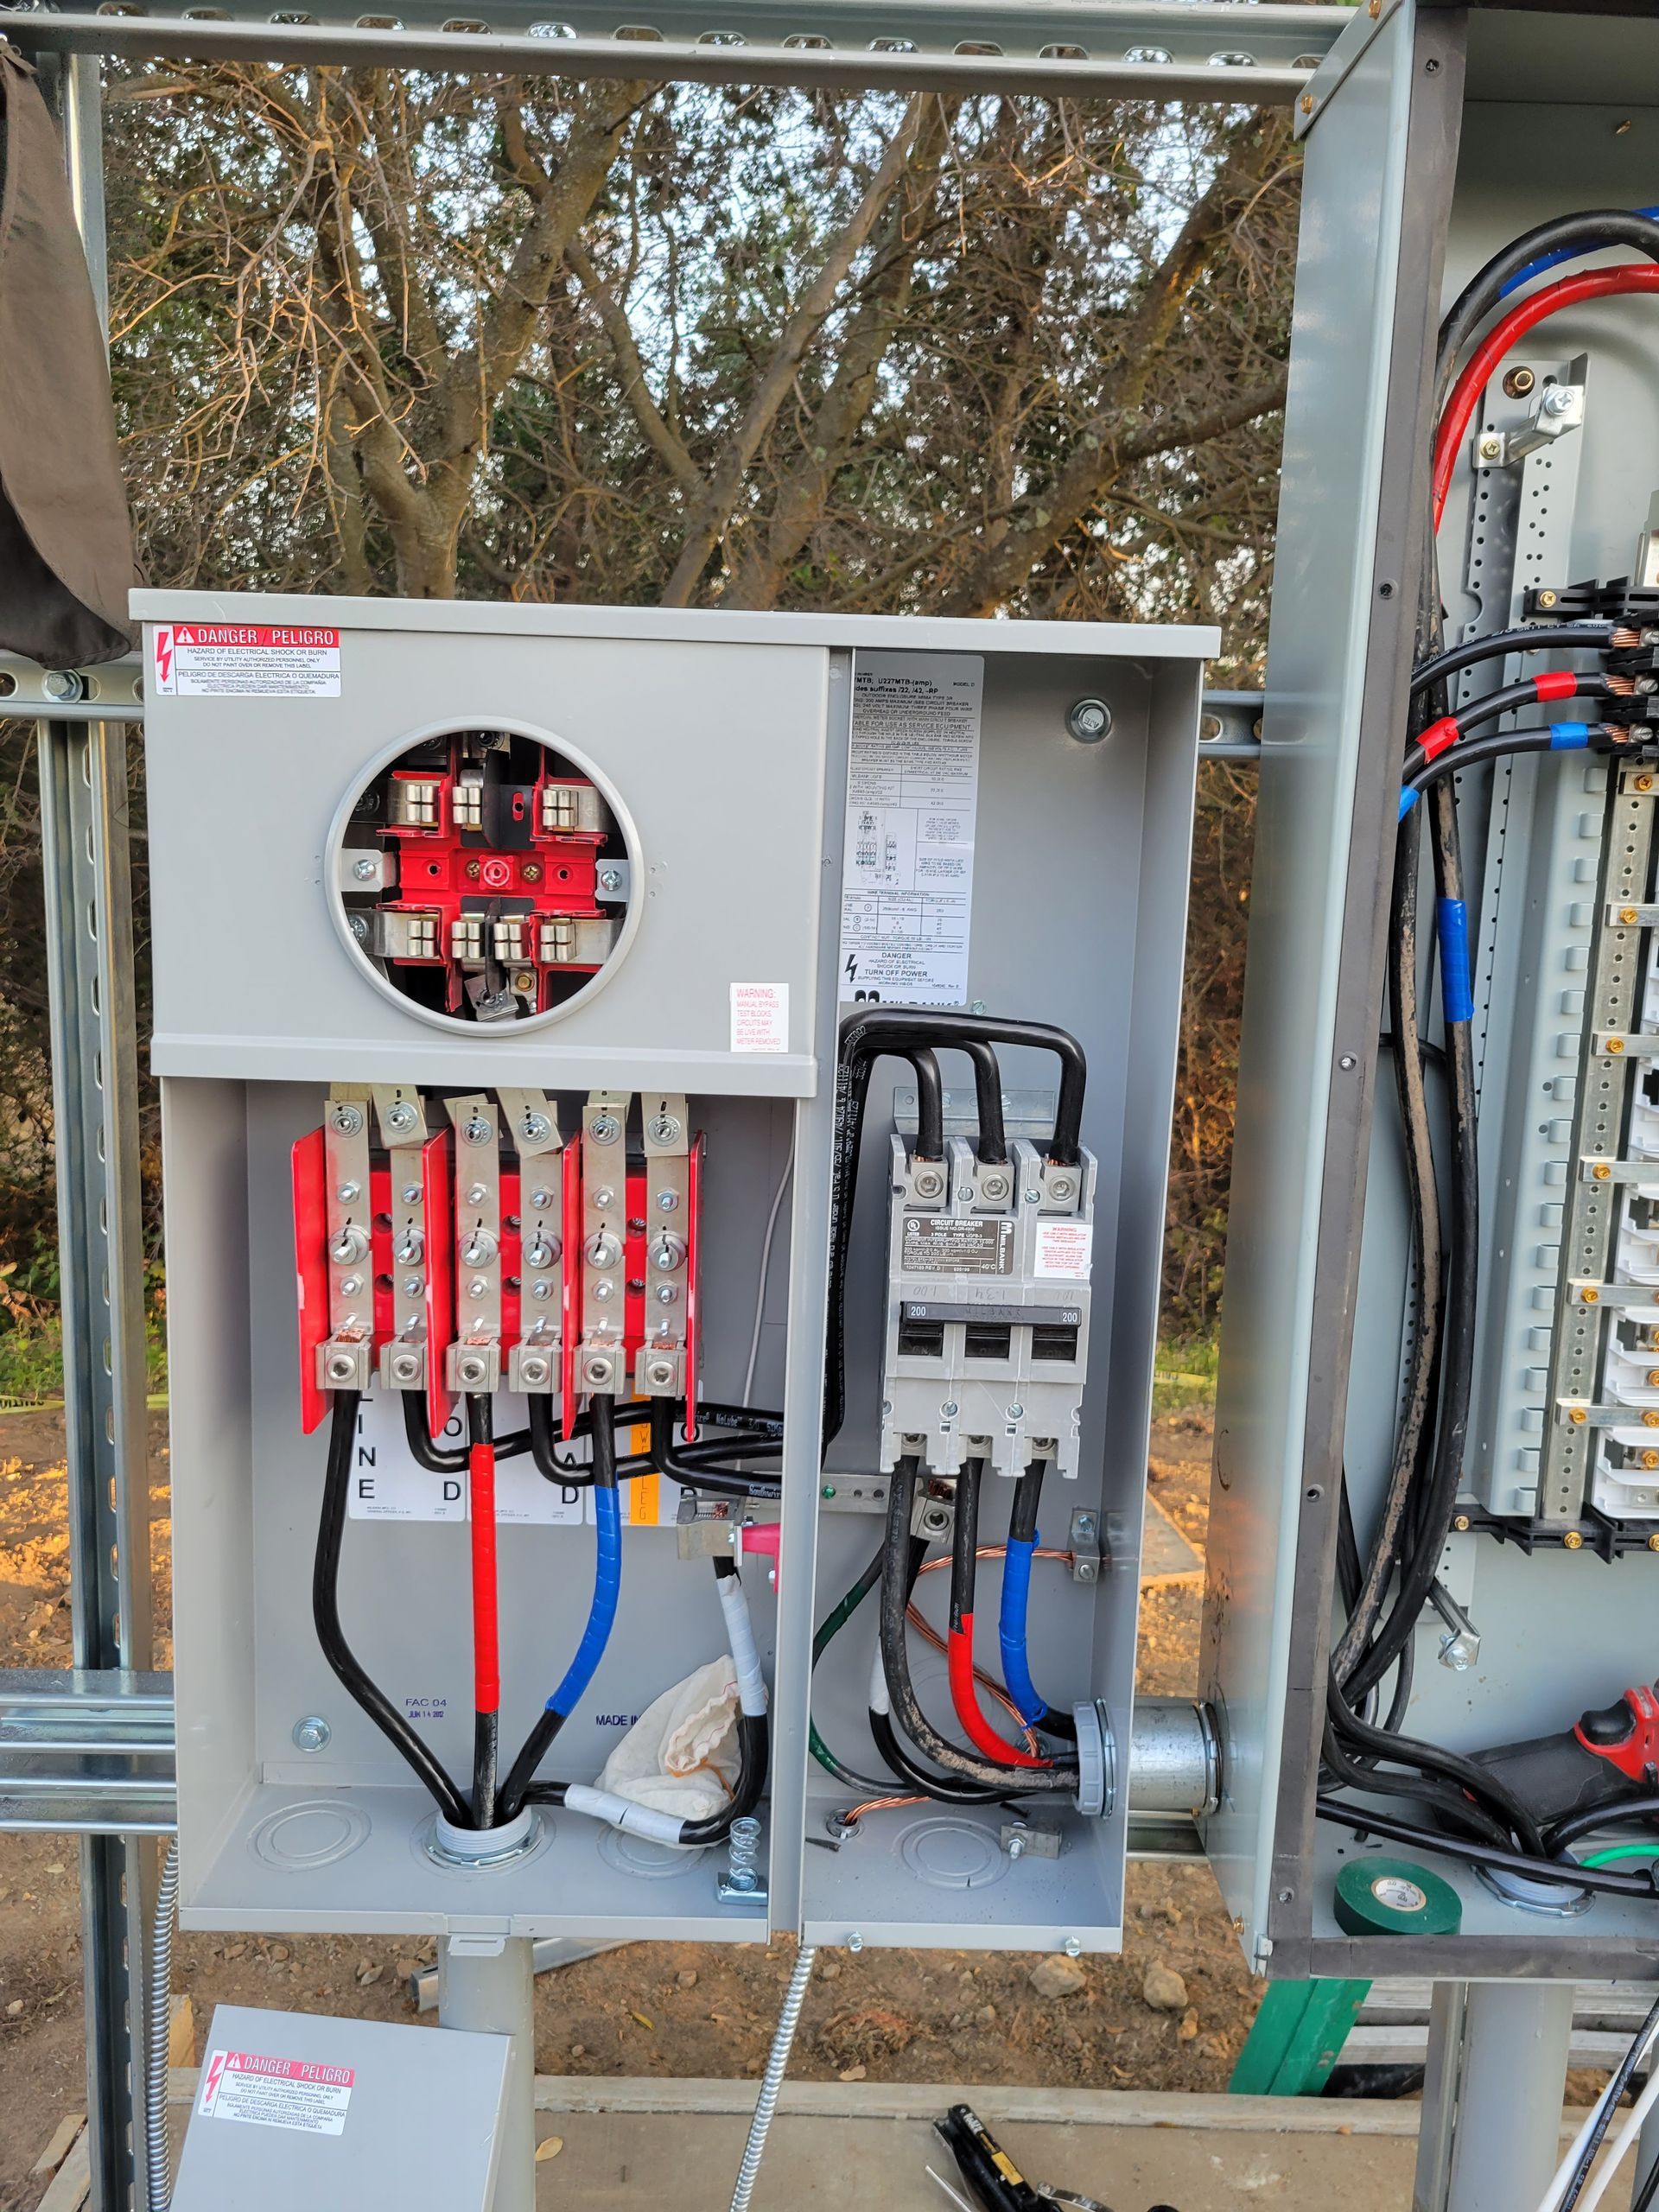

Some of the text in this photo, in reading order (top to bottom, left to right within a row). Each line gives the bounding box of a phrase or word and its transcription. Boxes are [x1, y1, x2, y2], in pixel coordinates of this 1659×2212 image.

[198, 629, 334, 645] DANGER PELIGRO
[911, 1306, 926, 1317] 200
[1062, 1312, 1077, 1323] 200
[748, 1484, 782, 1499] Southwir
[405, 1698, 448, 1707] FAC 04
[595, 1714, 627, 1726] MADE
[244, 2056, 351, 2084] DANGER PELIGRO
[232, 2073, 254, 2082] HAZARD
[264, 2077, 295, 2087] ELECTRICAL
[296, 2082, 315, 2091] SHOCK
[219, 2094, 242, 2102] PELIGRO
[250, 2098, 278, 2108] DESCARGA
[278, 2103, 307, 2113] ELECTRICA
[312, 2107, 345, 2117] QUEMADURA
